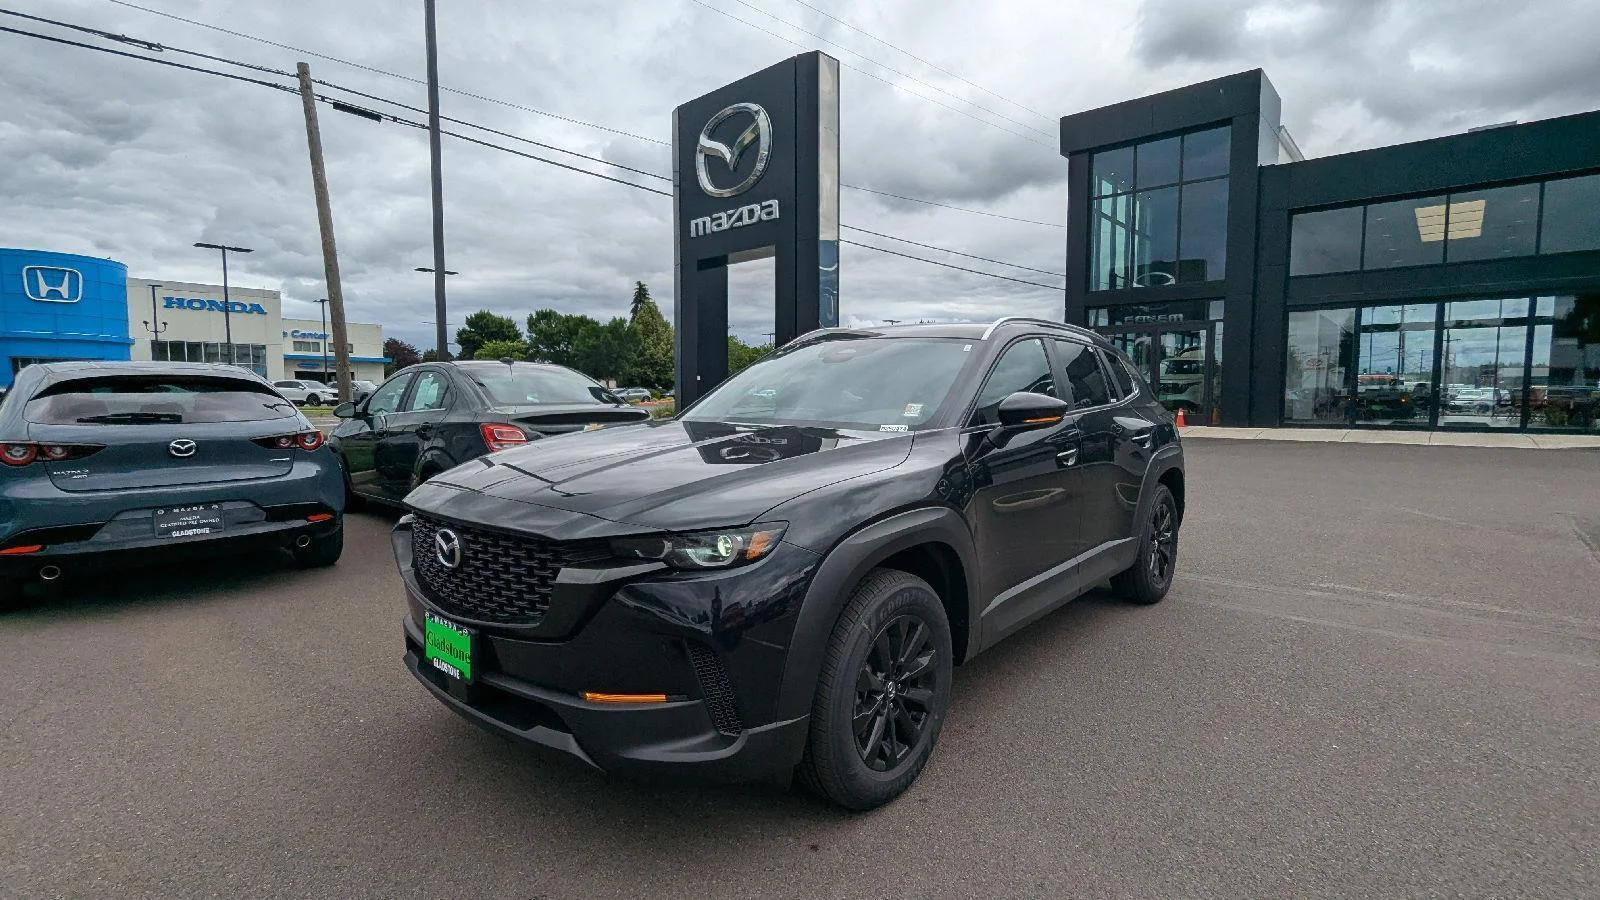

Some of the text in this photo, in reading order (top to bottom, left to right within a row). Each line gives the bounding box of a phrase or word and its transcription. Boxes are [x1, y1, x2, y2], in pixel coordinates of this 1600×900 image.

[162, 296, 267, 315] HONDA
[172, 528, 210, 538] GLADSTONE
[434, 615, 457, 632] MAZDA
[427, 630, 471, 664] Gladstone
[433, 658, 460, 680] GLADSTONE
